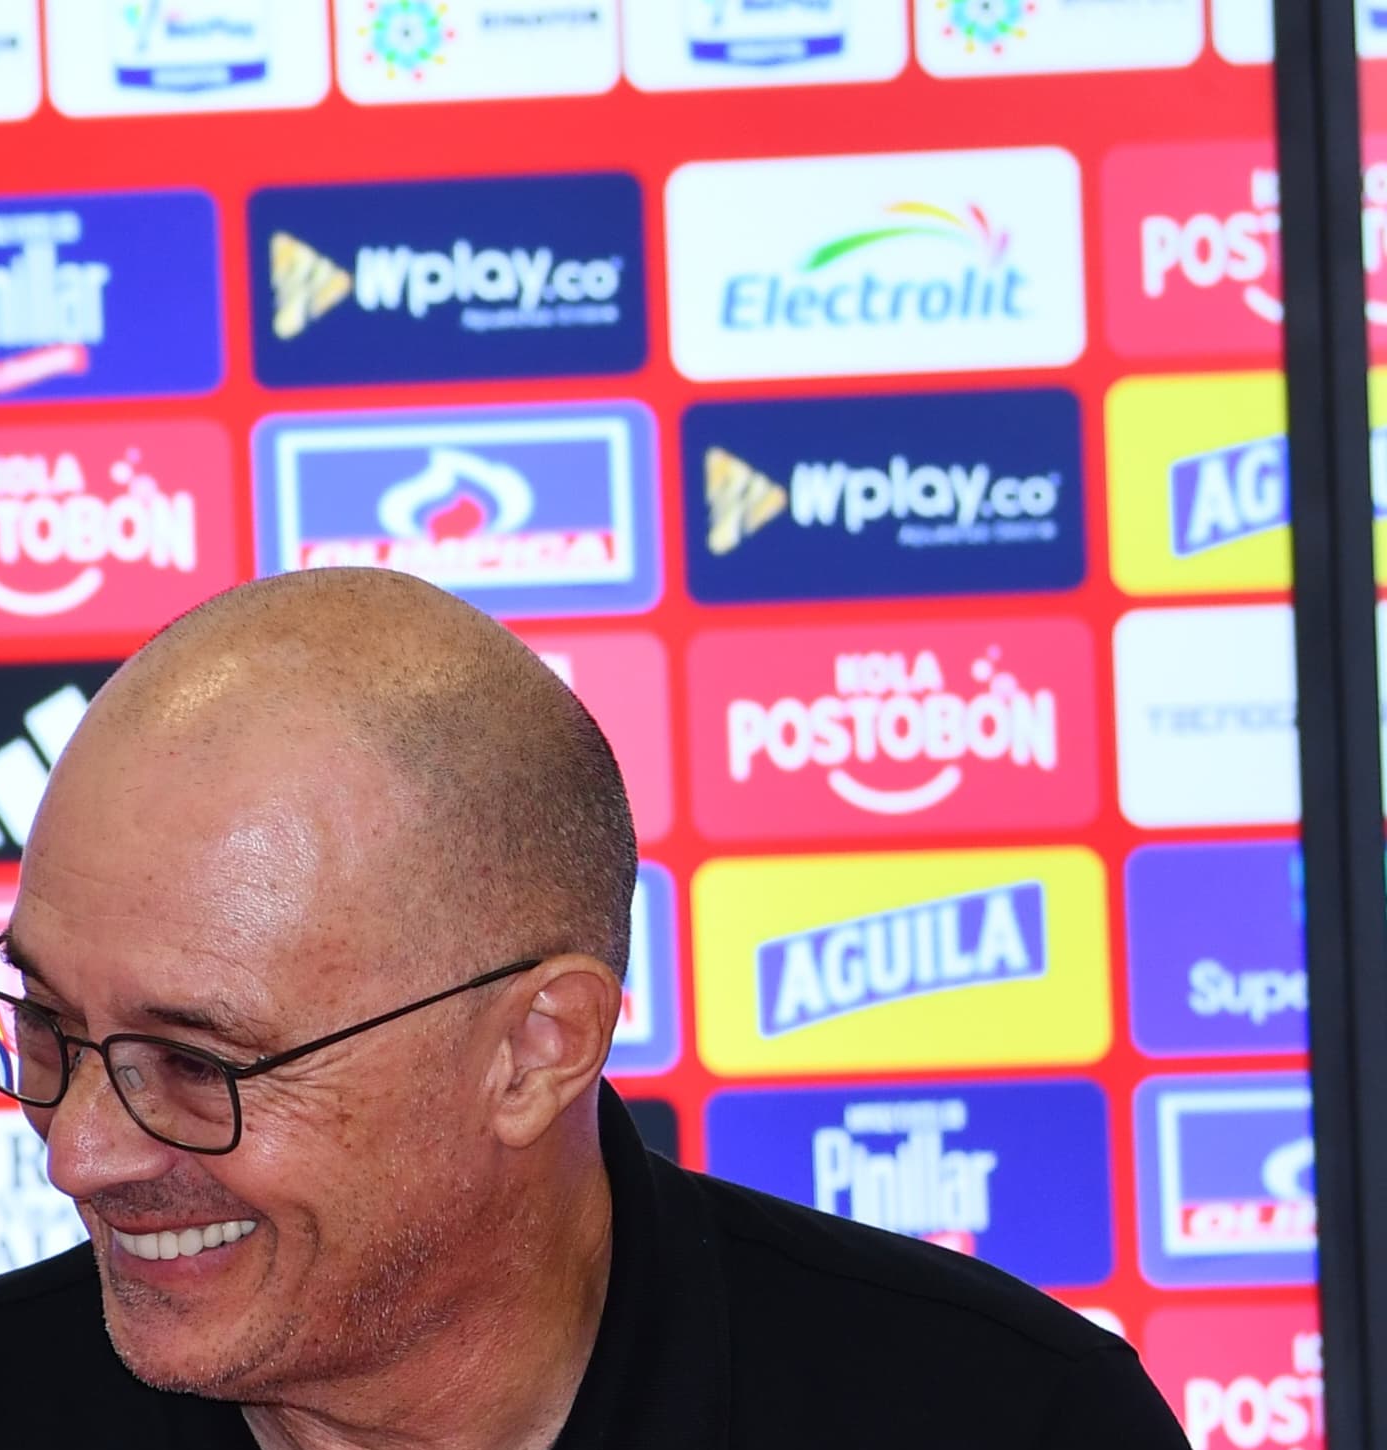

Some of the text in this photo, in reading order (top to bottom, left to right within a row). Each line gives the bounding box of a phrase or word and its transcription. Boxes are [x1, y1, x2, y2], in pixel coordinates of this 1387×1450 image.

[355, 240, 621, 317] Wplay.co
[720, 264, 1027, 331] Electrolit
[791, 455, 1057, 533] Wplay.co
[836, 651, 943, 695] KOLA
[777, 894, 1026, 1020] AGUILA
